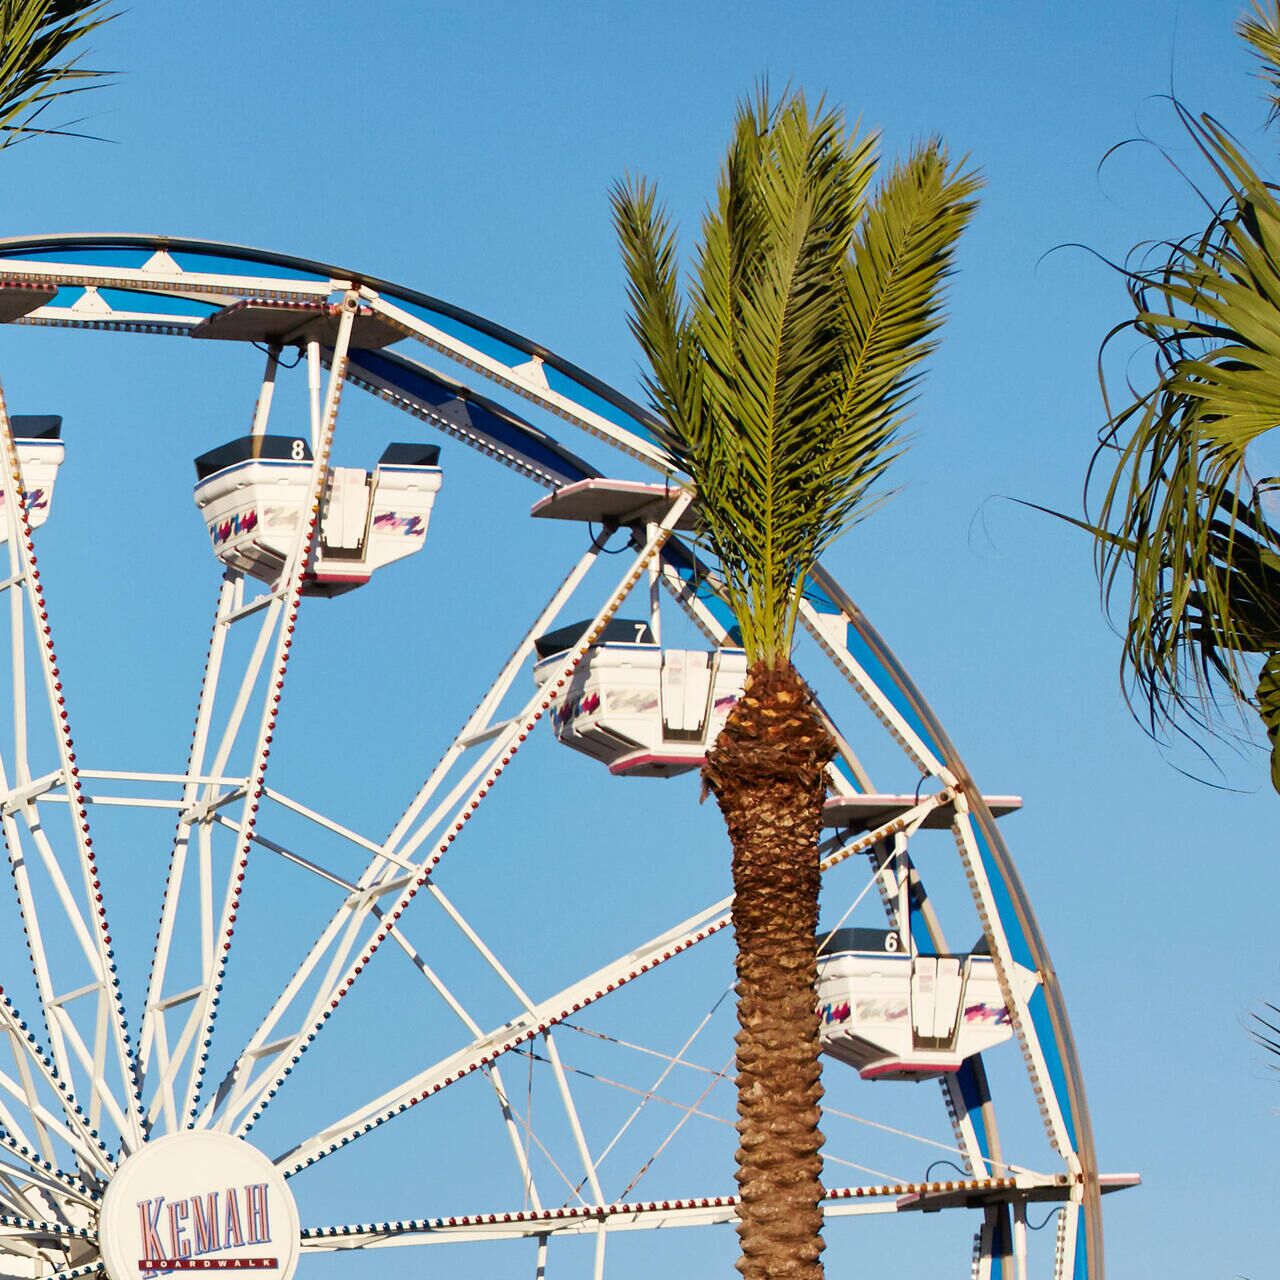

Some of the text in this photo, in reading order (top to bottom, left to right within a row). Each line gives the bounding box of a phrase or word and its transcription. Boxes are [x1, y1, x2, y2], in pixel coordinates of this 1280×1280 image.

[292, 440, 304, 460] 8
[635, 624, 647, 643] 7
[885, 931, 898, 952] 6
[137, 1183, 272, 1279] KEMAH
[145, 1259, 271, 1269] BOARDWALK
